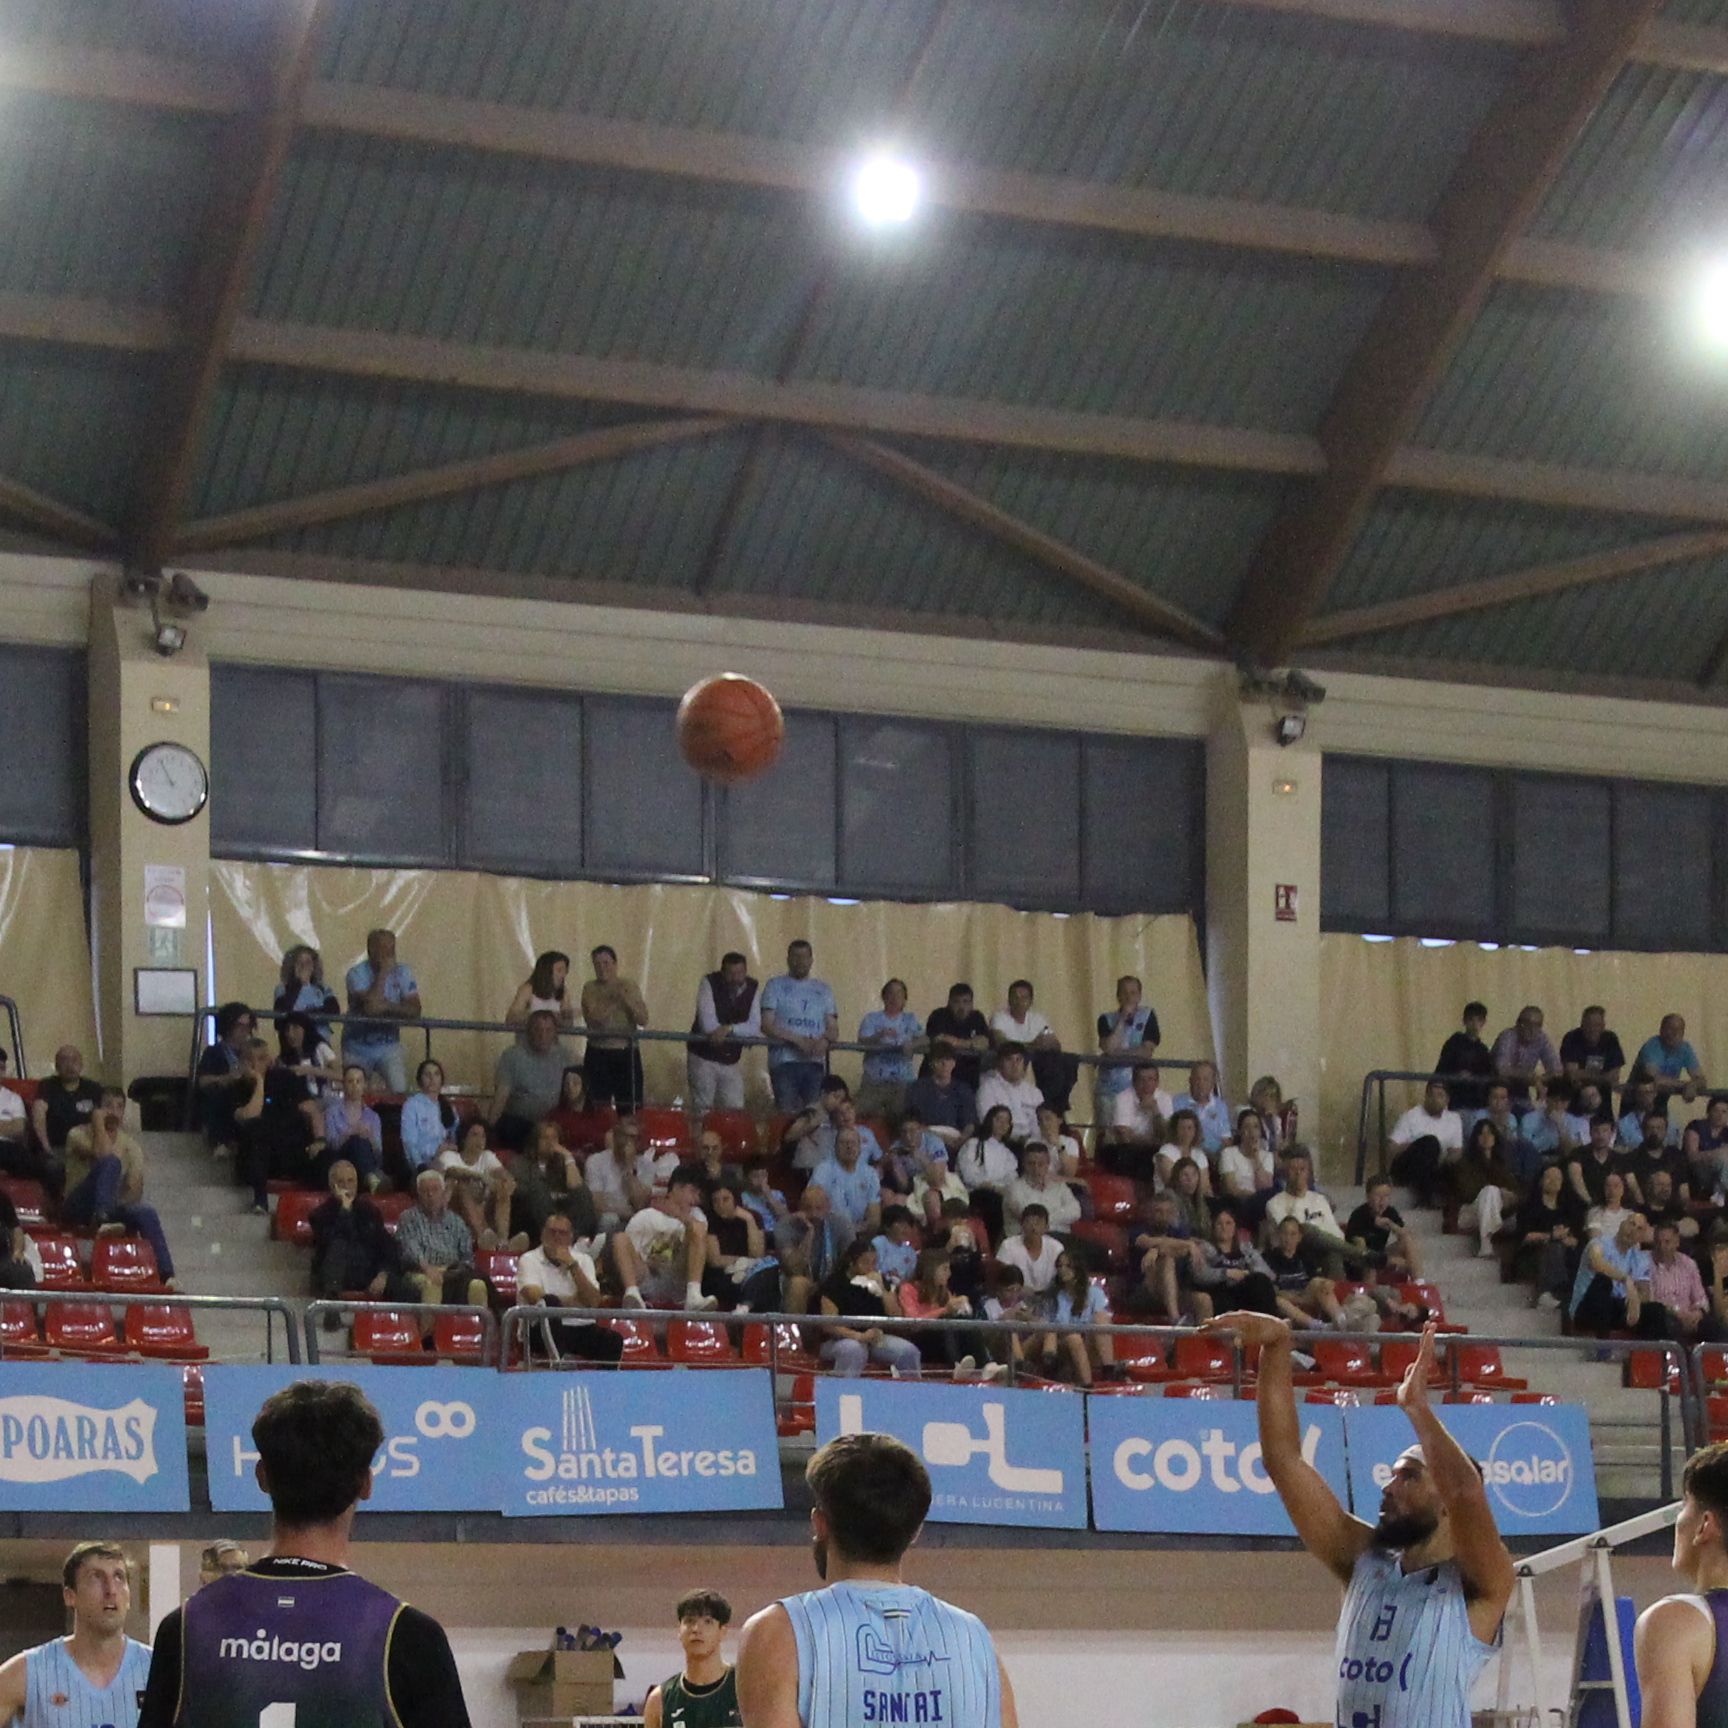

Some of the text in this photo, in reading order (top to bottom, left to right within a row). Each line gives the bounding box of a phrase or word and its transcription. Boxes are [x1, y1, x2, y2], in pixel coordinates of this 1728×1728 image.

[971, 1497, 1065, 1512] LUCENTINA
[272, 1557, 328, 1571] NIKE PRO
